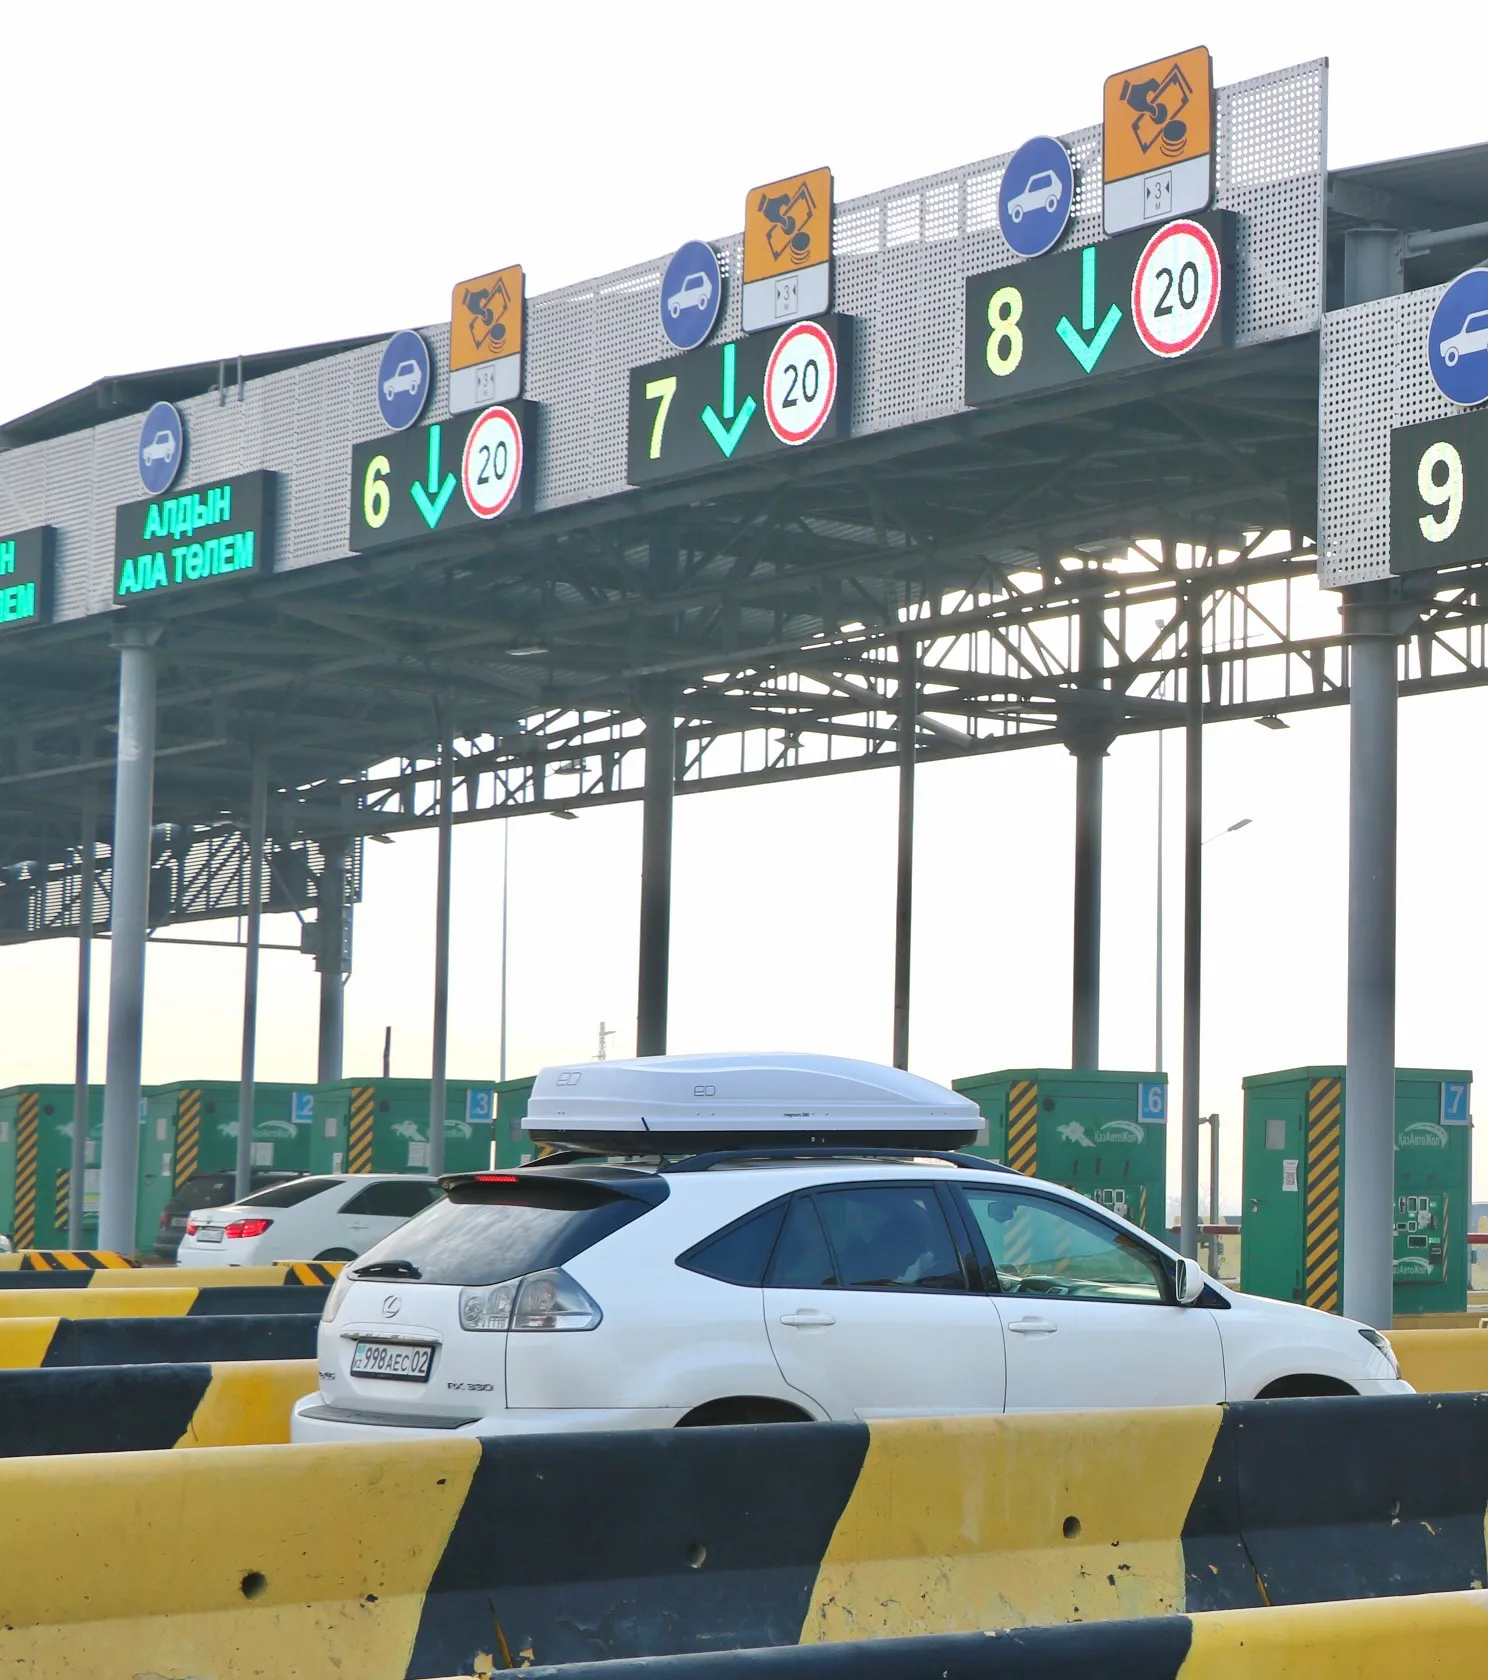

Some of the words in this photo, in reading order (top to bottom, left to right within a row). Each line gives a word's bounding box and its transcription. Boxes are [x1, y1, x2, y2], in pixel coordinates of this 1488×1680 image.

[1155, 182, 1162, 199] 3
[784, 285, 790, 300] 3
[1153, 261, 1199, 317] 20
[986, 287, 1023, 376] 8
[782, 359, 819, 408] 20
[646, 376, 677, 459] 7
[477, 441, 507, 485] 20
[143, 485, 232, 540] АЛДЫН
[364, 455, 391, 529] 6
[1418, 442, 1464, 543] 9
[117, 552, 169, 596] АЛА
[172, 531, 255, 583] ТӨЛЕМ
[302, 1095, 314, 1115] 2
[476, 1093, 488, 1114] 3
[1148, 1087, 1163, 1112] 6
[1450, 1086, 1464, 1113] 7
